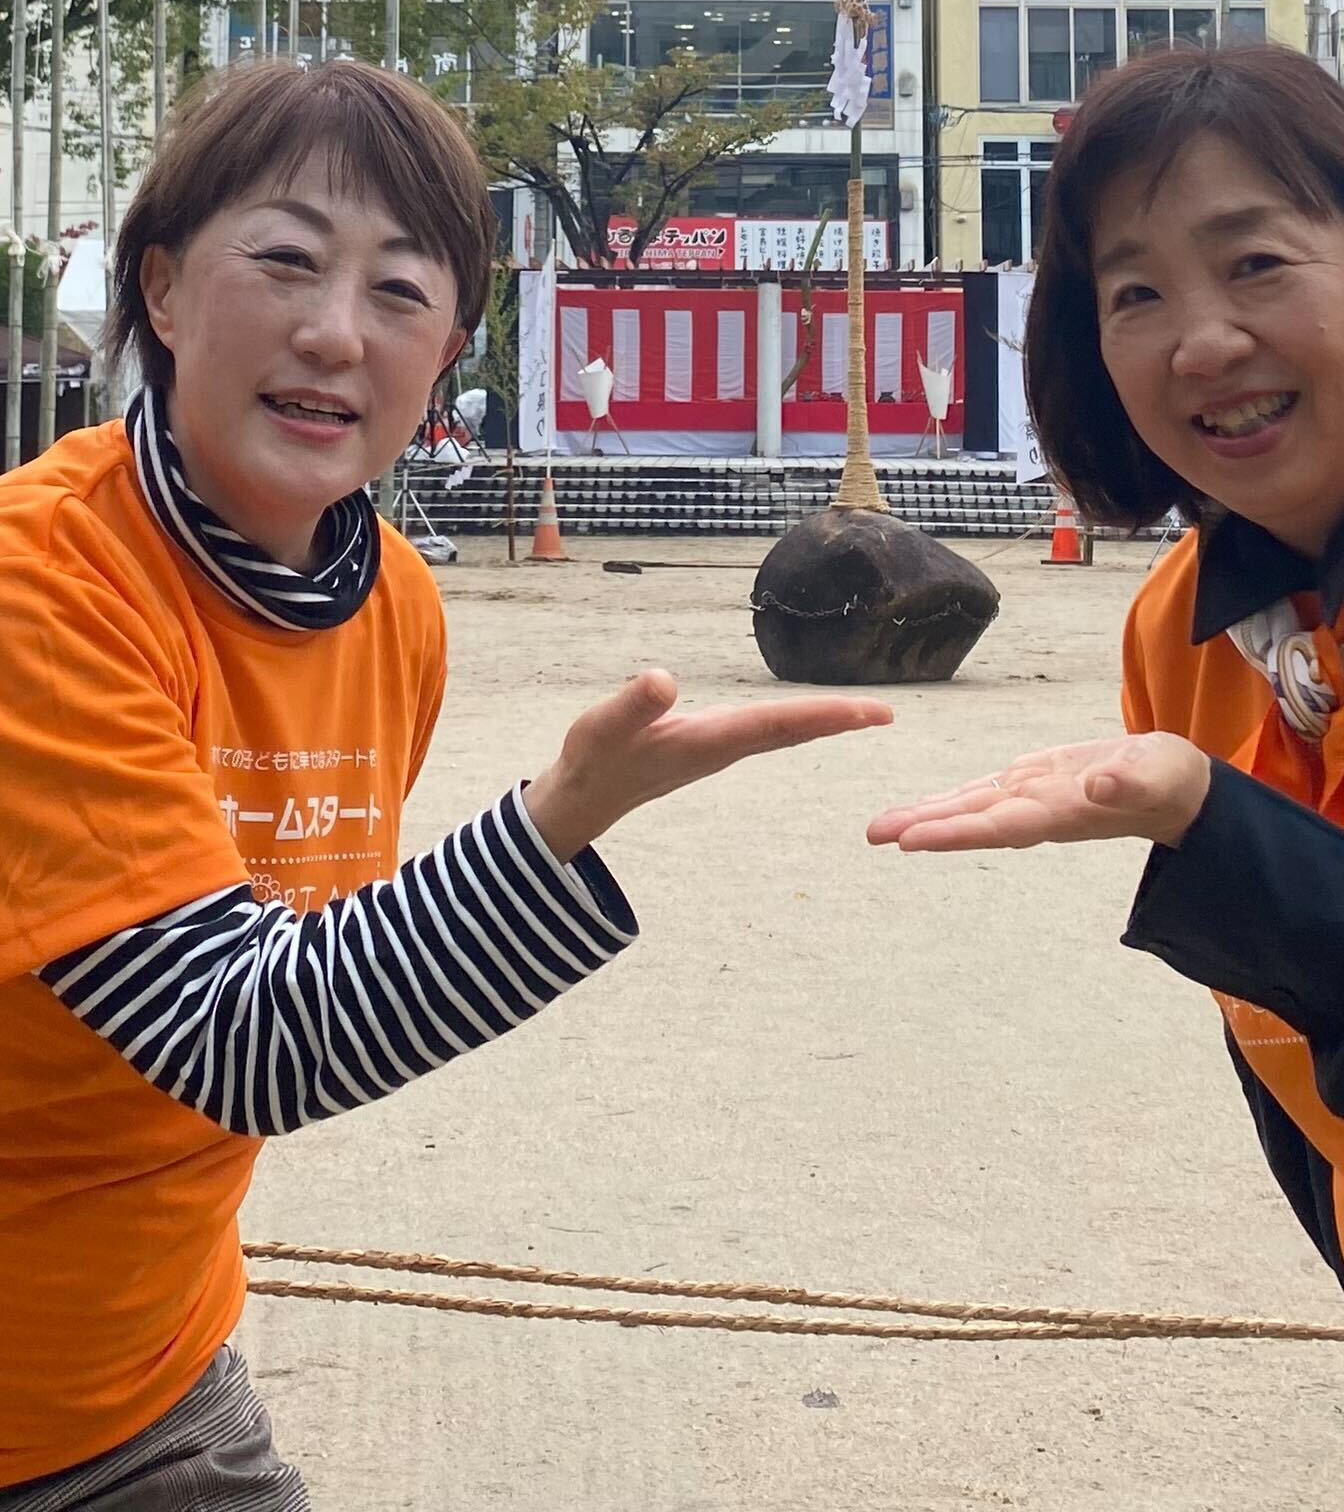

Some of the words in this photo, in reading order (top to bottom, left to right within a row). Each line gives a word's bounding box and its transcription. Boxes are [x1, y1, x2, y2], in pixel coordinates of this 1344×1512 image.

[608, 227, 727, 246] ろテッパン
[218, 793, 382, 840] ホームスタート
